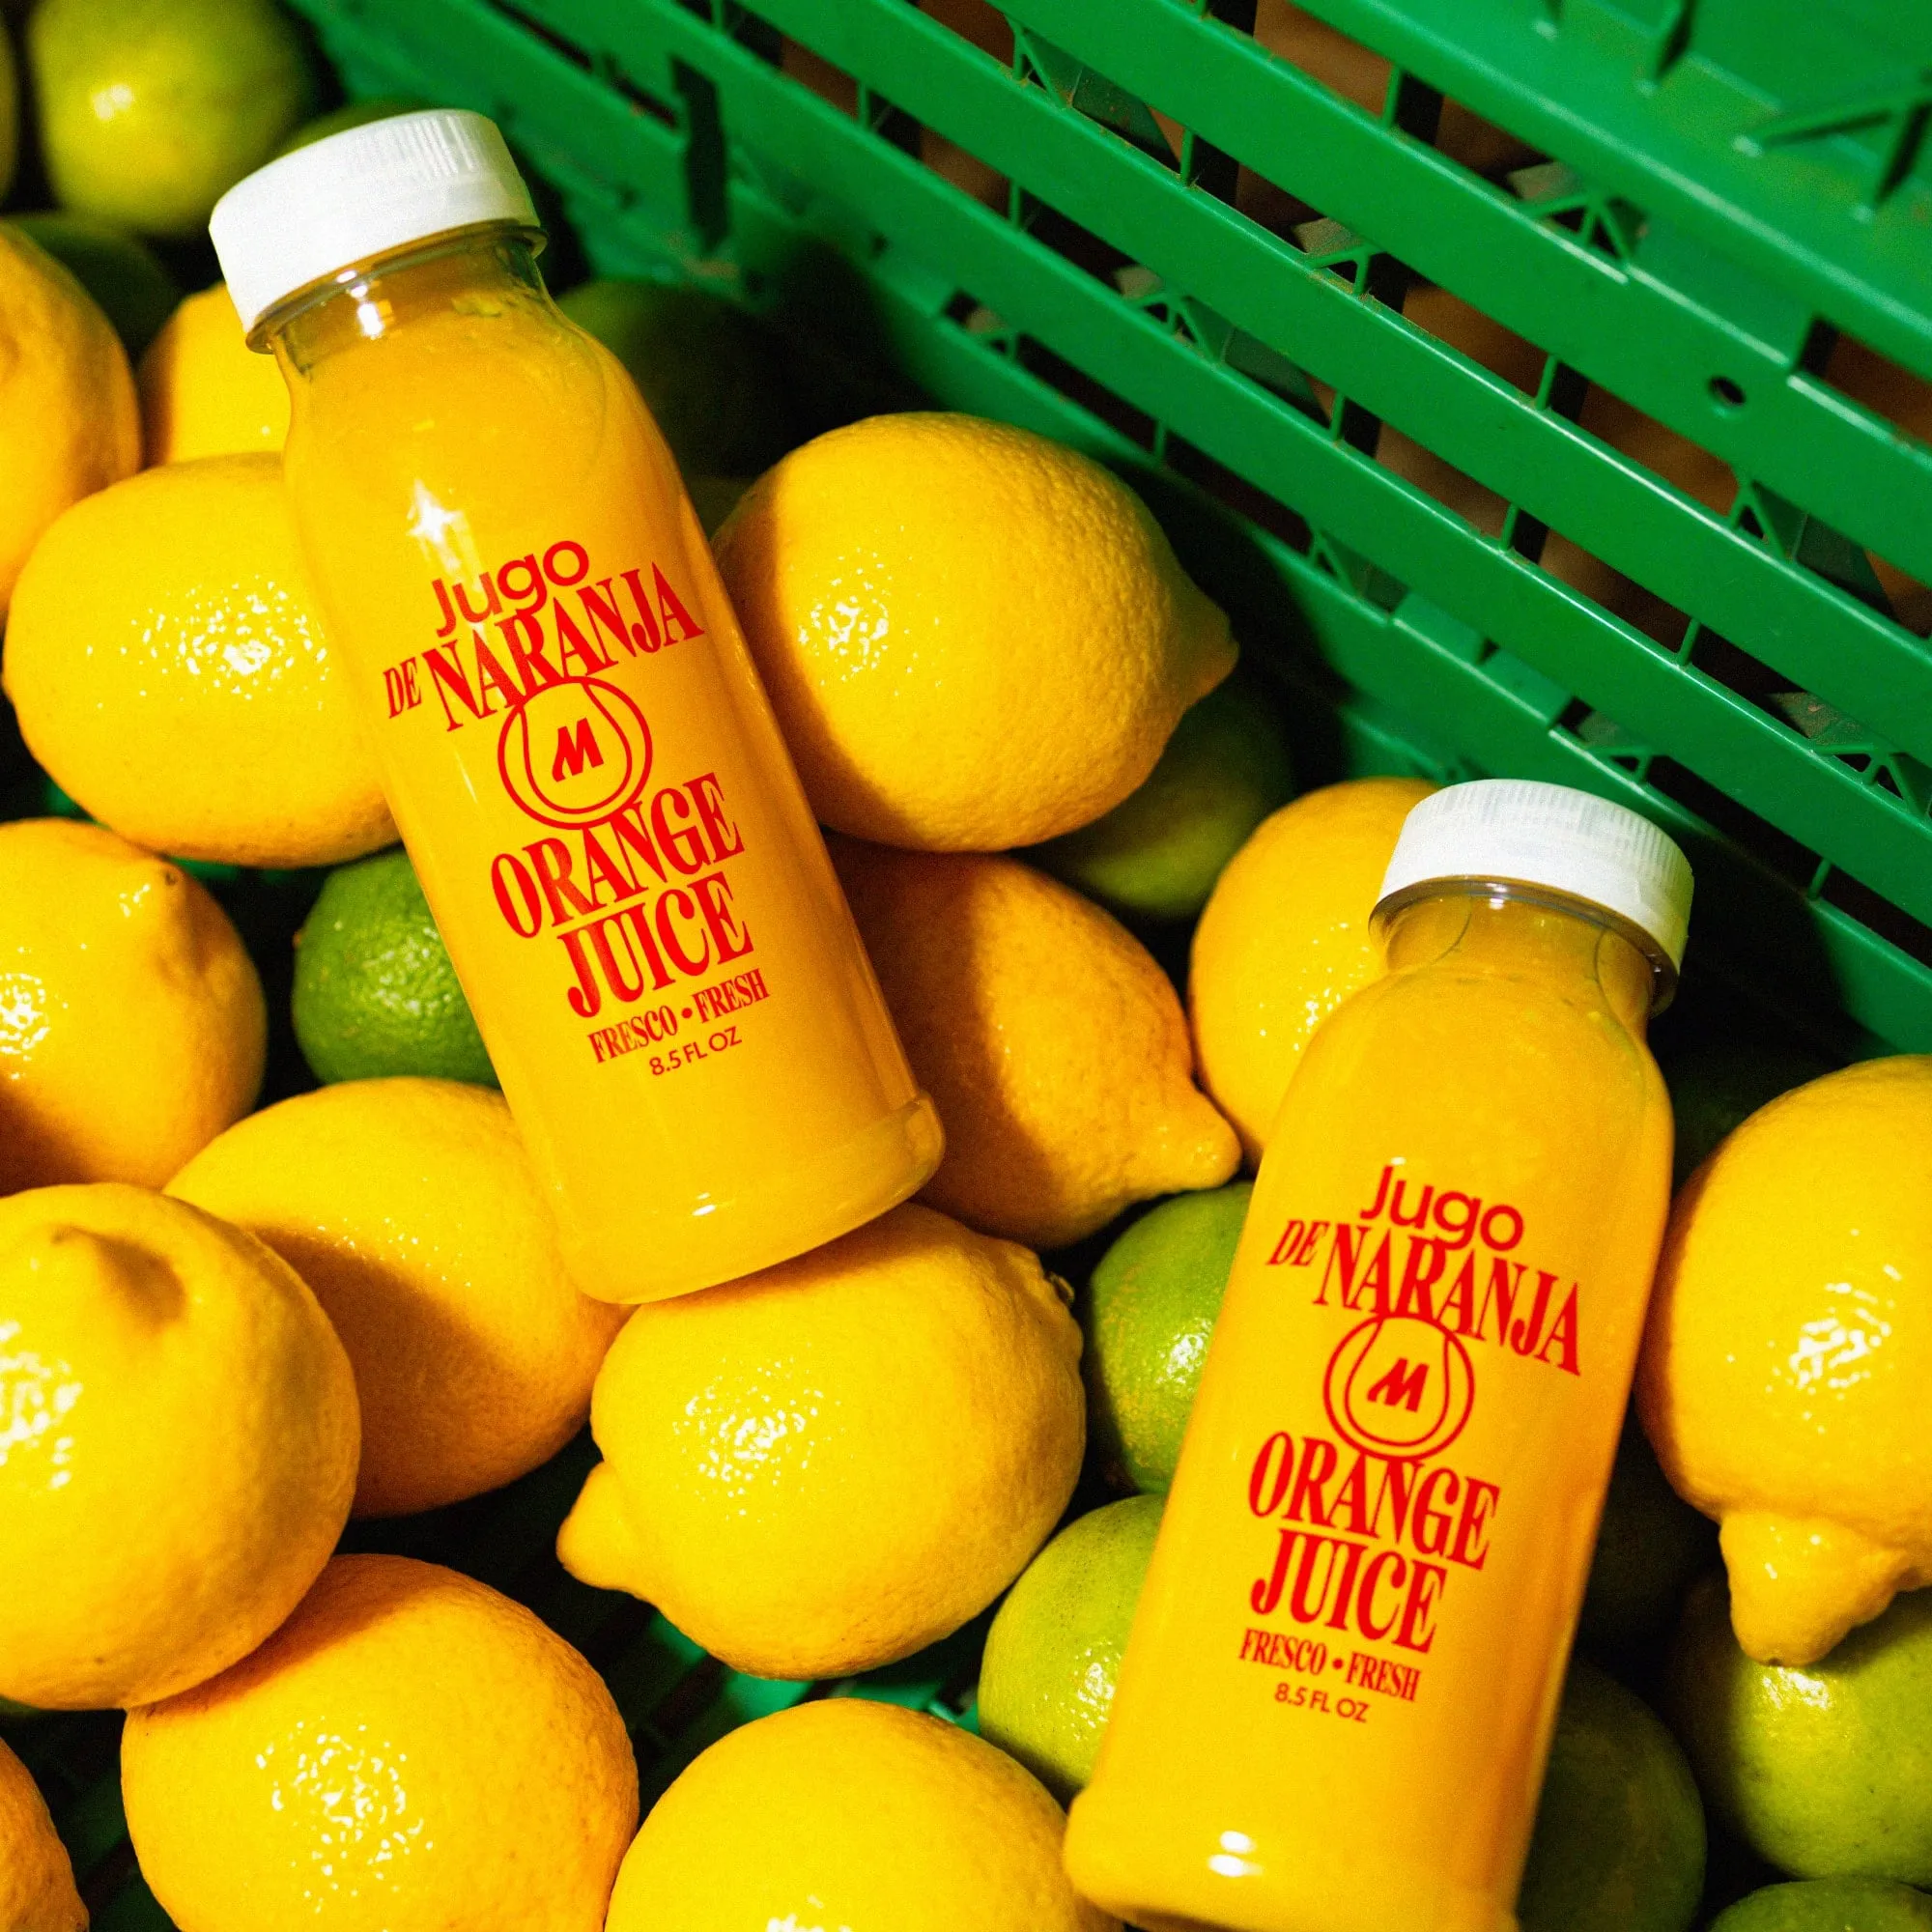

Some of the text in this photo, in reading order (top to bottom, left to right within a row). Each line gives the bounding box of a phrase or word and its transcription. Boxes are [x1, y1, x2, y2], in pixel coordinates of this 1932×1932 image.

[431, 540, 589, 638] Jugo
[383, 561, 705, 732] DE NARANJA
[552, 718, 604, 781] M
[490, 772, 745, 938] ORANGE
[556, 871, 754, 1018] JUICE
[587, 968, 770, 1063] FRESCO FRESH
[649, 1026, 742, 1075] 8.5 FL OZ
[1359, 1164, 1524, 1252] Jugo
[1265, 1219, 1581, 1378] DE NARANJA
[1367, 1357, 1429, 1412] M
[1247, 1431, 1501, 1571] ORANGE
[1250, 1528, 1448, 1654] JUICE
[1239, 1628, 1421, 1701] FRESCO FRESH
[1274, 1682, 1370, 1723] 8.5 FL OZ
